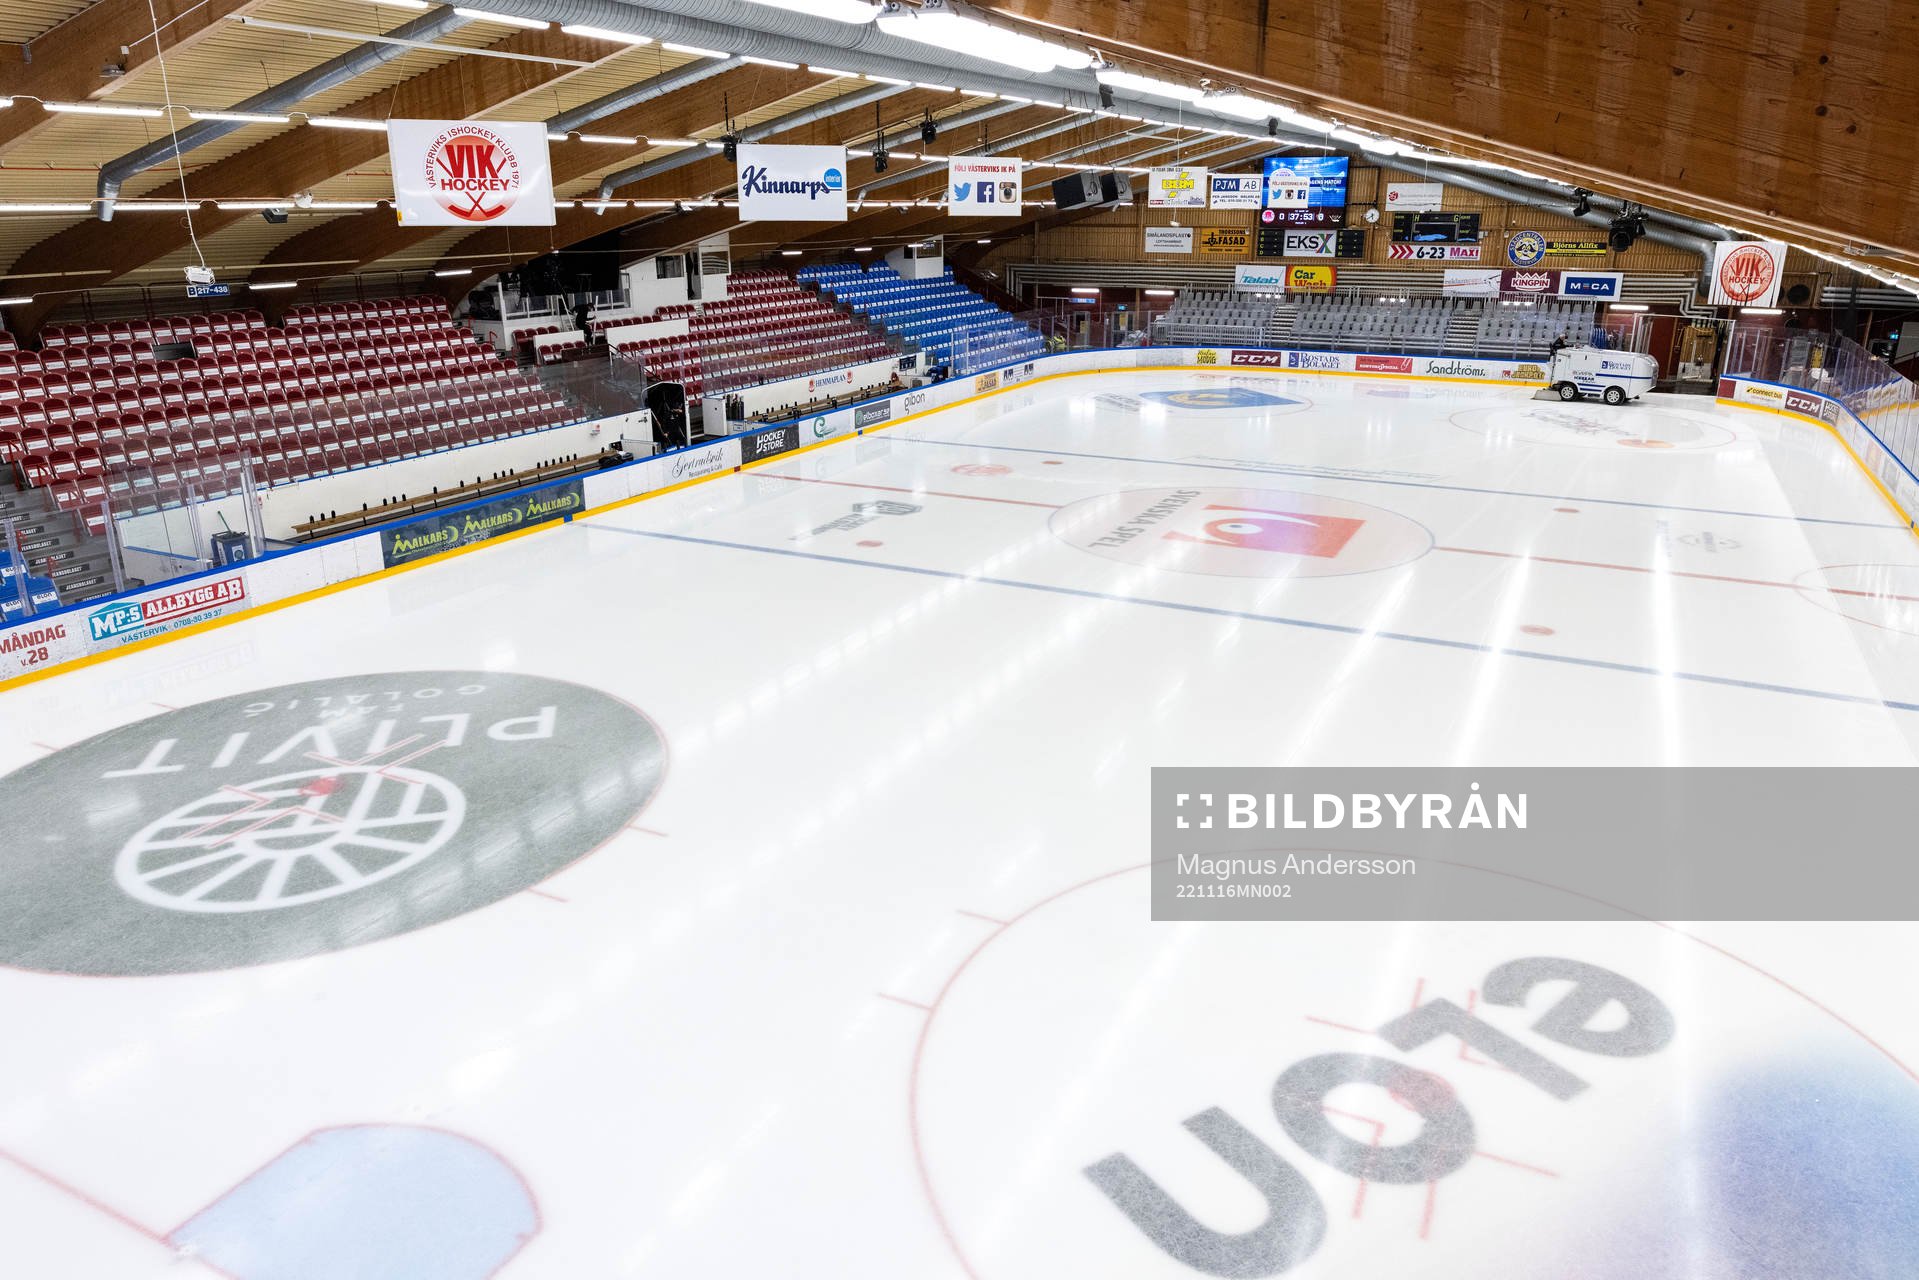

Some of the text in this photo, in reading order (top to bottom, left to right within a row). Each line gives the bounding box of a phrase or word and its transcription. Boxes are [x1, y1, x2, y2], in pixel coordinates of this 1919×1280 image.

[425, 126, 520, 189] VÄSTERVIKS ISHOCKEY KLUBB 1971
[444, 144, 500, 179] VIK
[968, 163, 1000, 173] VÄSTERVIKS
[1008, 163, 1016, 173] PÅ
[440, 178, 510, 191] HOCKEY
[741, 164, 831, 200] Kinnarps
[1215, 180, 1257, 190] PJM AB
[1289, 213, 1313, 221] 37:53
[1453, 214, 1459, 222] G
[1218, 236, 1246, 245] FASAD
[1553, 242, 1577, 250] Björns
[1416, 246, 1445, 259] 6-23
[1735, 257, 1763, 277] VIK
[1294, 270, 1316, 279] Car
[1728, 276, 1766, 285] HOCKEY
[1511, 278, 1550, 287] KINGPIN
[187, 285, 228, 296] B 217-438
[1232, 354, 1279, 364] CCM
[1300, 353, 1340, 362] BOSTADS
[1301, 360, 1341, 369] BOLAGET
[815, 375, 847, 388] HEMMAPLAN
[1753, 388, 1774, 397] connect
[1786, 396, 1820, 413] CCM
[757, 429, 786, 449] HOCKEY
[763, 438, 784, 452] STORE
[526, 496, 572, 517] MALKARS
[462, 512, 513, 536] MALKARS
[1087, 489, 1201, 548] SVENSKA SPEL
[392, 530, 449, 555] MALKARS
[65, 579, 97, 591] JEANSBOLAGET
[37, 592, 53, 600] elon
[91, 579, 243, 639] MP:S ALLBYGG AB
[0, 624, 67, 655] MÅNDAG
[101, 705, 558, 779] PLIVIT
[1082, 955, 1676, 1280] elon
